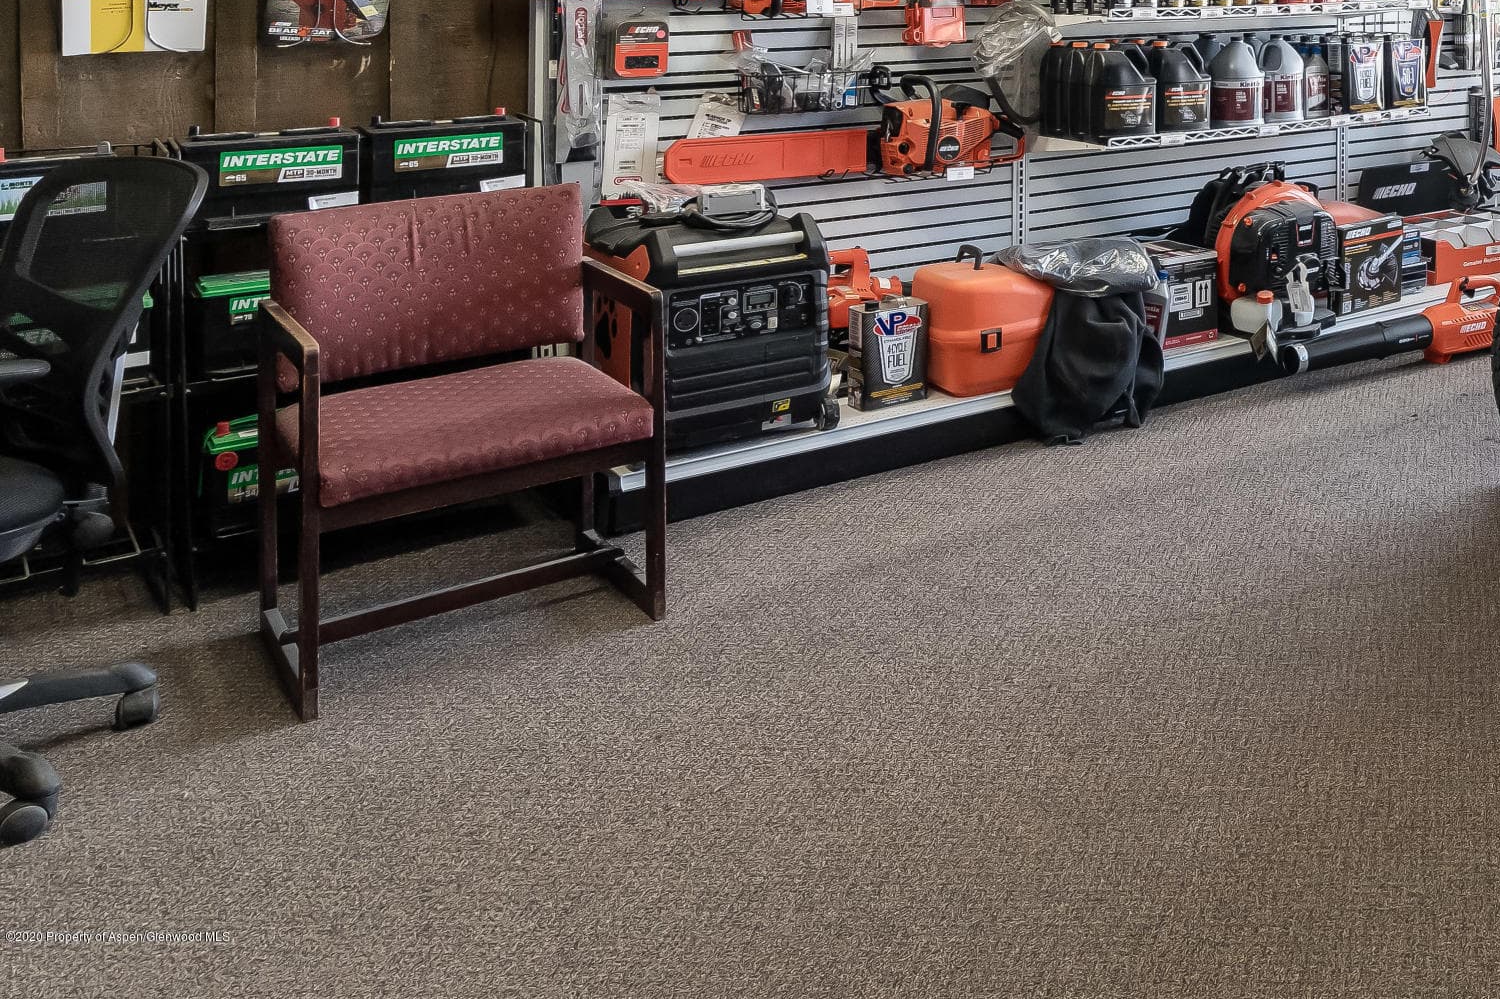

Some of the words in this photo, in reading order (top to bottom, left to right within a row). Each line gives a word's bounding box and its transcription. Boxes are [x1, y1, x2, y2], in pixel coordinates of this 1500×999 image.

[149, 2, 179, 11] Meyer
[1352, 46, 1371, 64] VP
[397, 137, 500, 155] INTERSTATE
[222, 150, 339, 168] INTERSTATE
[284, 169, 304, 179] MTP
[1382, 183, 1416, 199] ECHO
[876, 312, 907, 336] VP
[887, 353, 908, 368] FUEL
